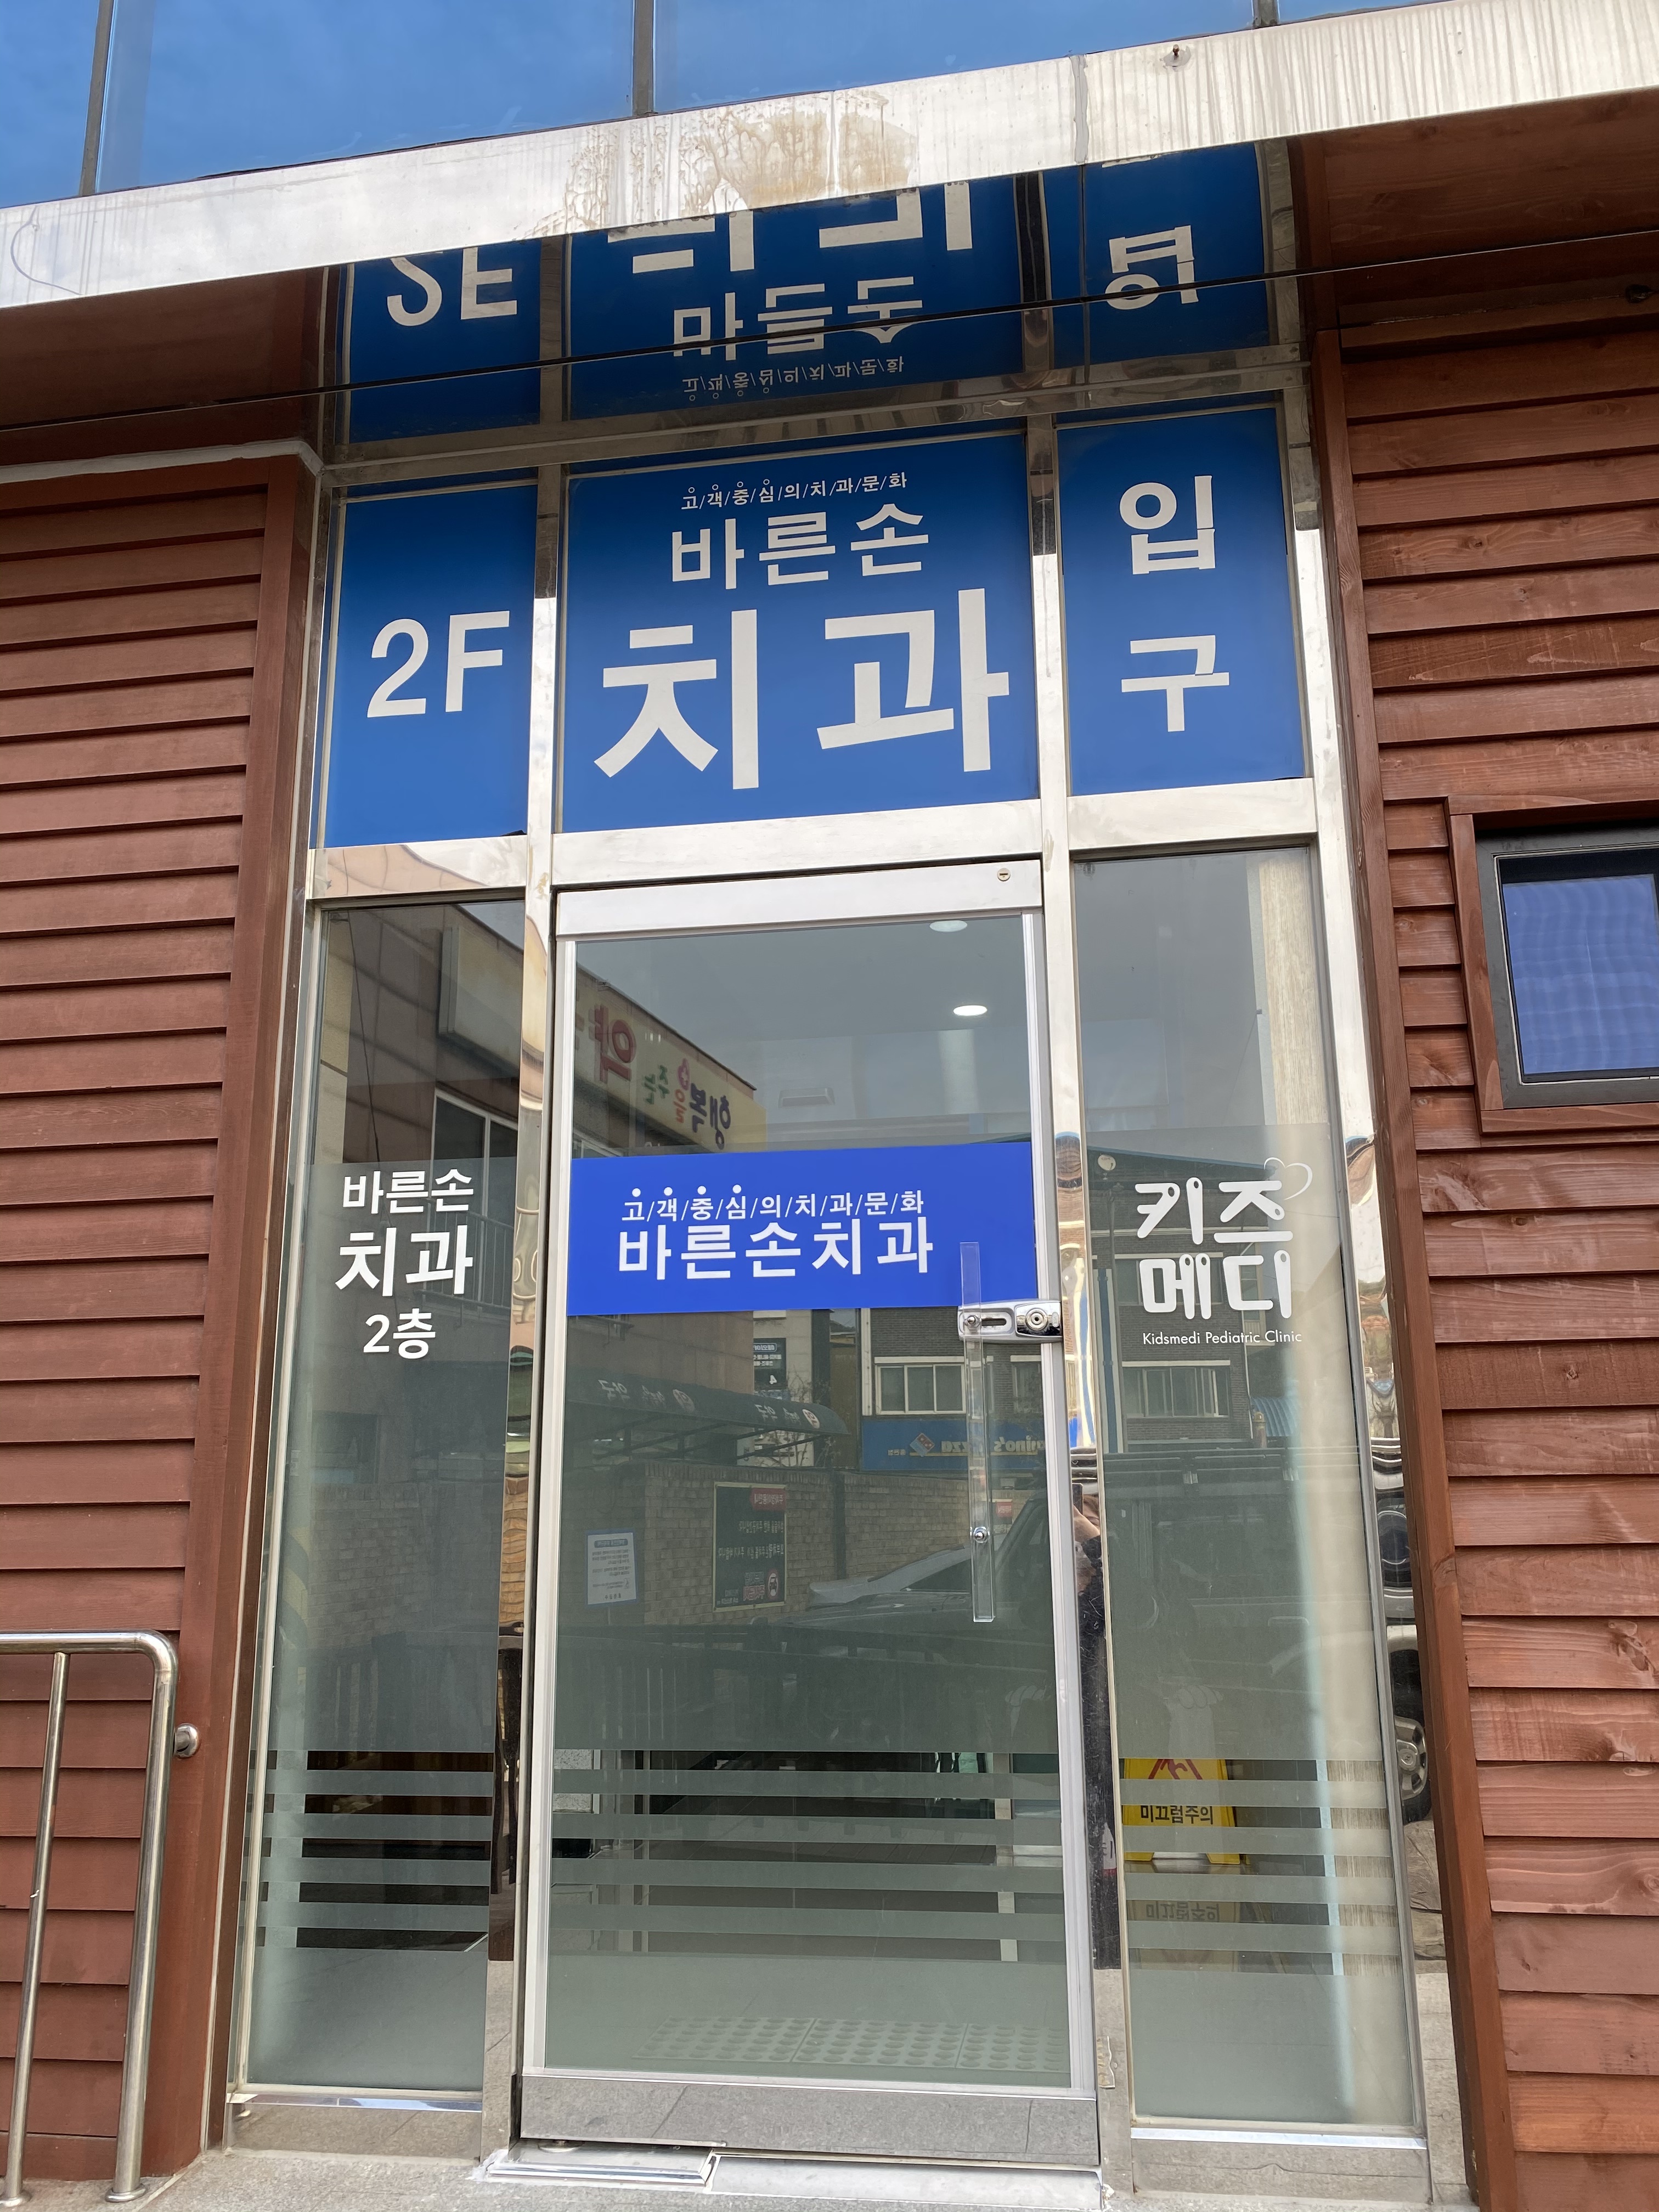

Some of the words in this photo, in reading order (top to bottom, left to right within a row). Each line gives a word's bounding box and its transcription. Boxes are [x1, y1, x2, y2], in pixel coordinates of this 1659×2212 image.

[672, 503, 929, 589] 바른손
[1119, 475, 1229, 732] 입구
[367, 610, 510, 718] 2F
[594, 588, 1009, 790] 치과
[343, 1169, 473, 1214] 바른손
[1135, 1177, 1293, 1245] 키즈
[335, 1224, 473, 1296] 치과
[619, 1216, 933, 1280] 바른손치과
[1139, 1250, 1292, 1319] 메디
[363, 1308, 436, 1359] 2층
[1143, 1331, 1200, 1345] Kidsmedi
[1205, 1331, 1260, 1344] Pediatric
[1265, 1330, 1302, 1342] Clinic
[1140, 1805, 1214, 1825] 미끄럼주의
